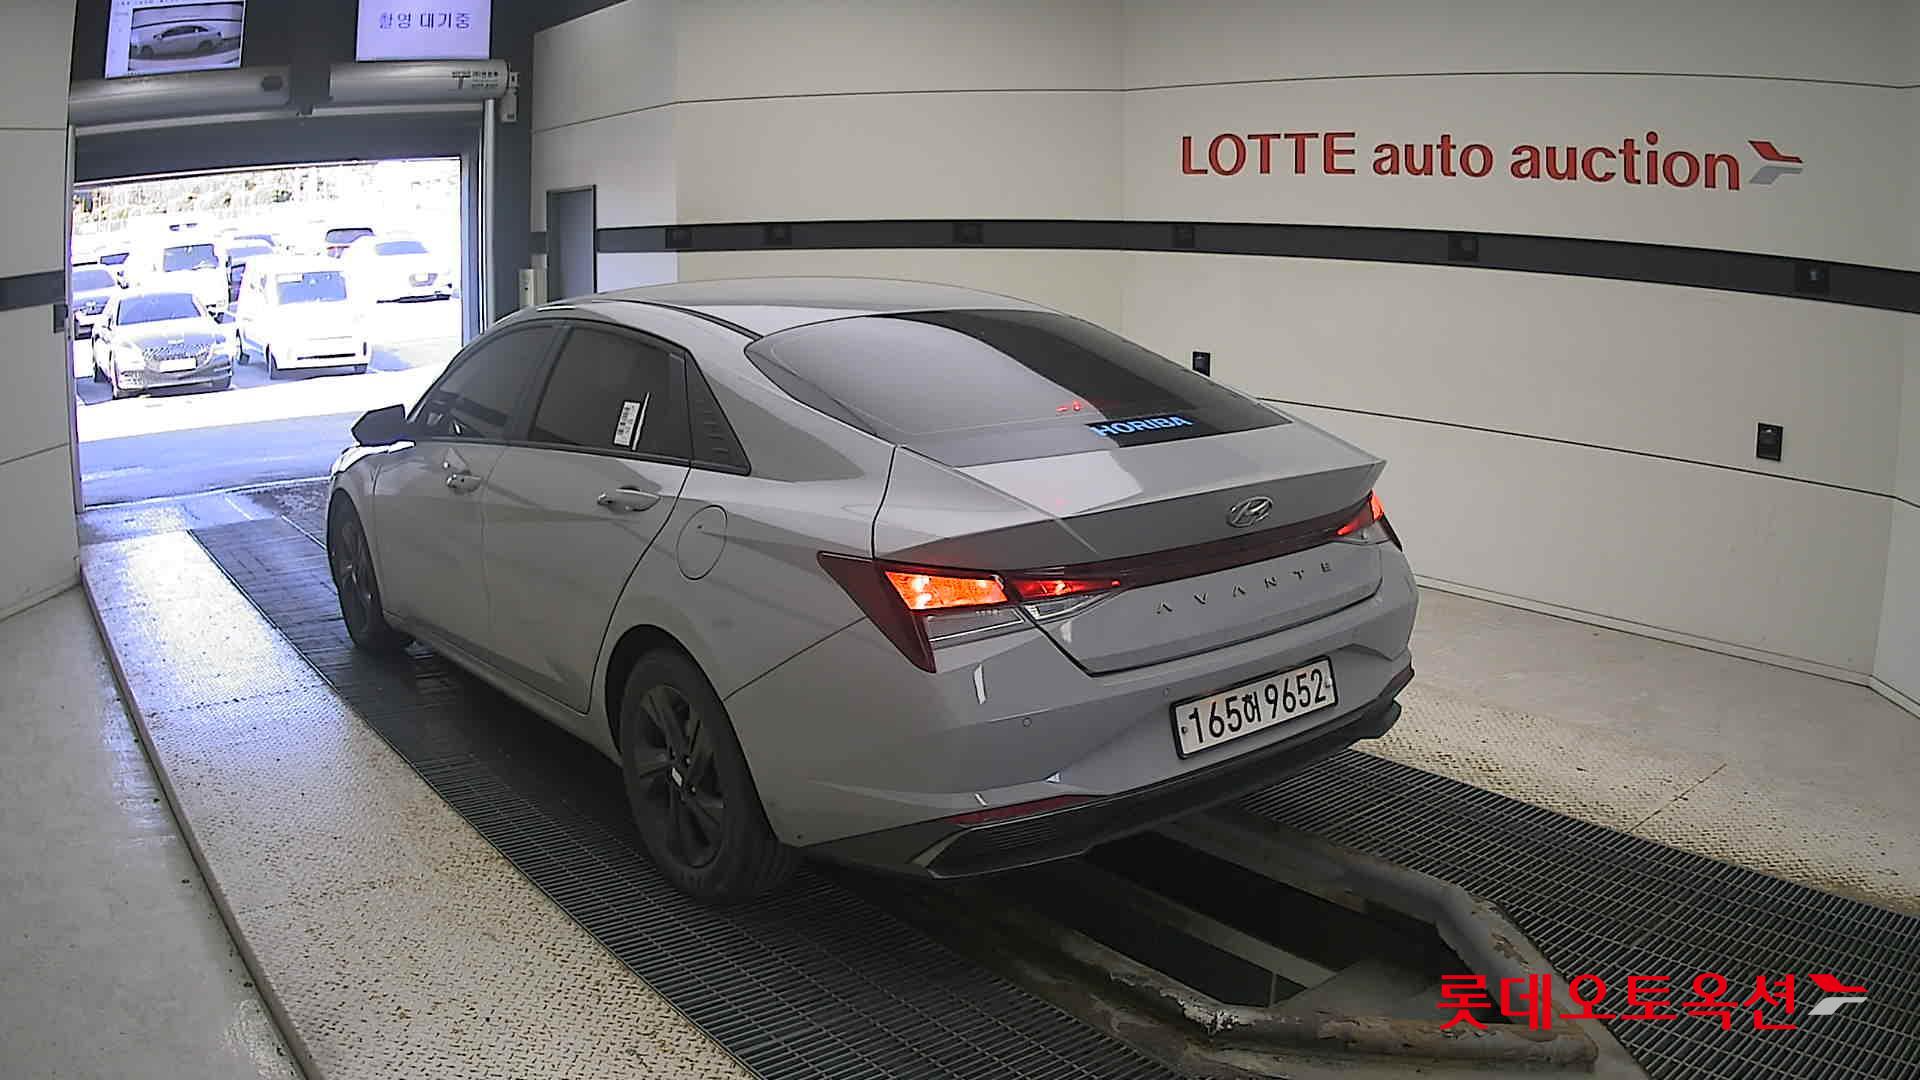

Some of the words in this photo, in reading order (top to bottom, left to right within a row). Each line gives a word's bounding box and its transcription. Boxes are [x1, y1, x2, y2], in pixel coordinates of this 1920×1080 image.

[419, 12, 470, 29] 대기중
[1182, 131, 1356, 176] LOTTE
[1373, 134, 1494, 177] auto
[1510, 132, 1741, 191] auction
[1088, 416, 1192, 438] HORIBA
[1156, 561, 1332, 615] AVANTE
